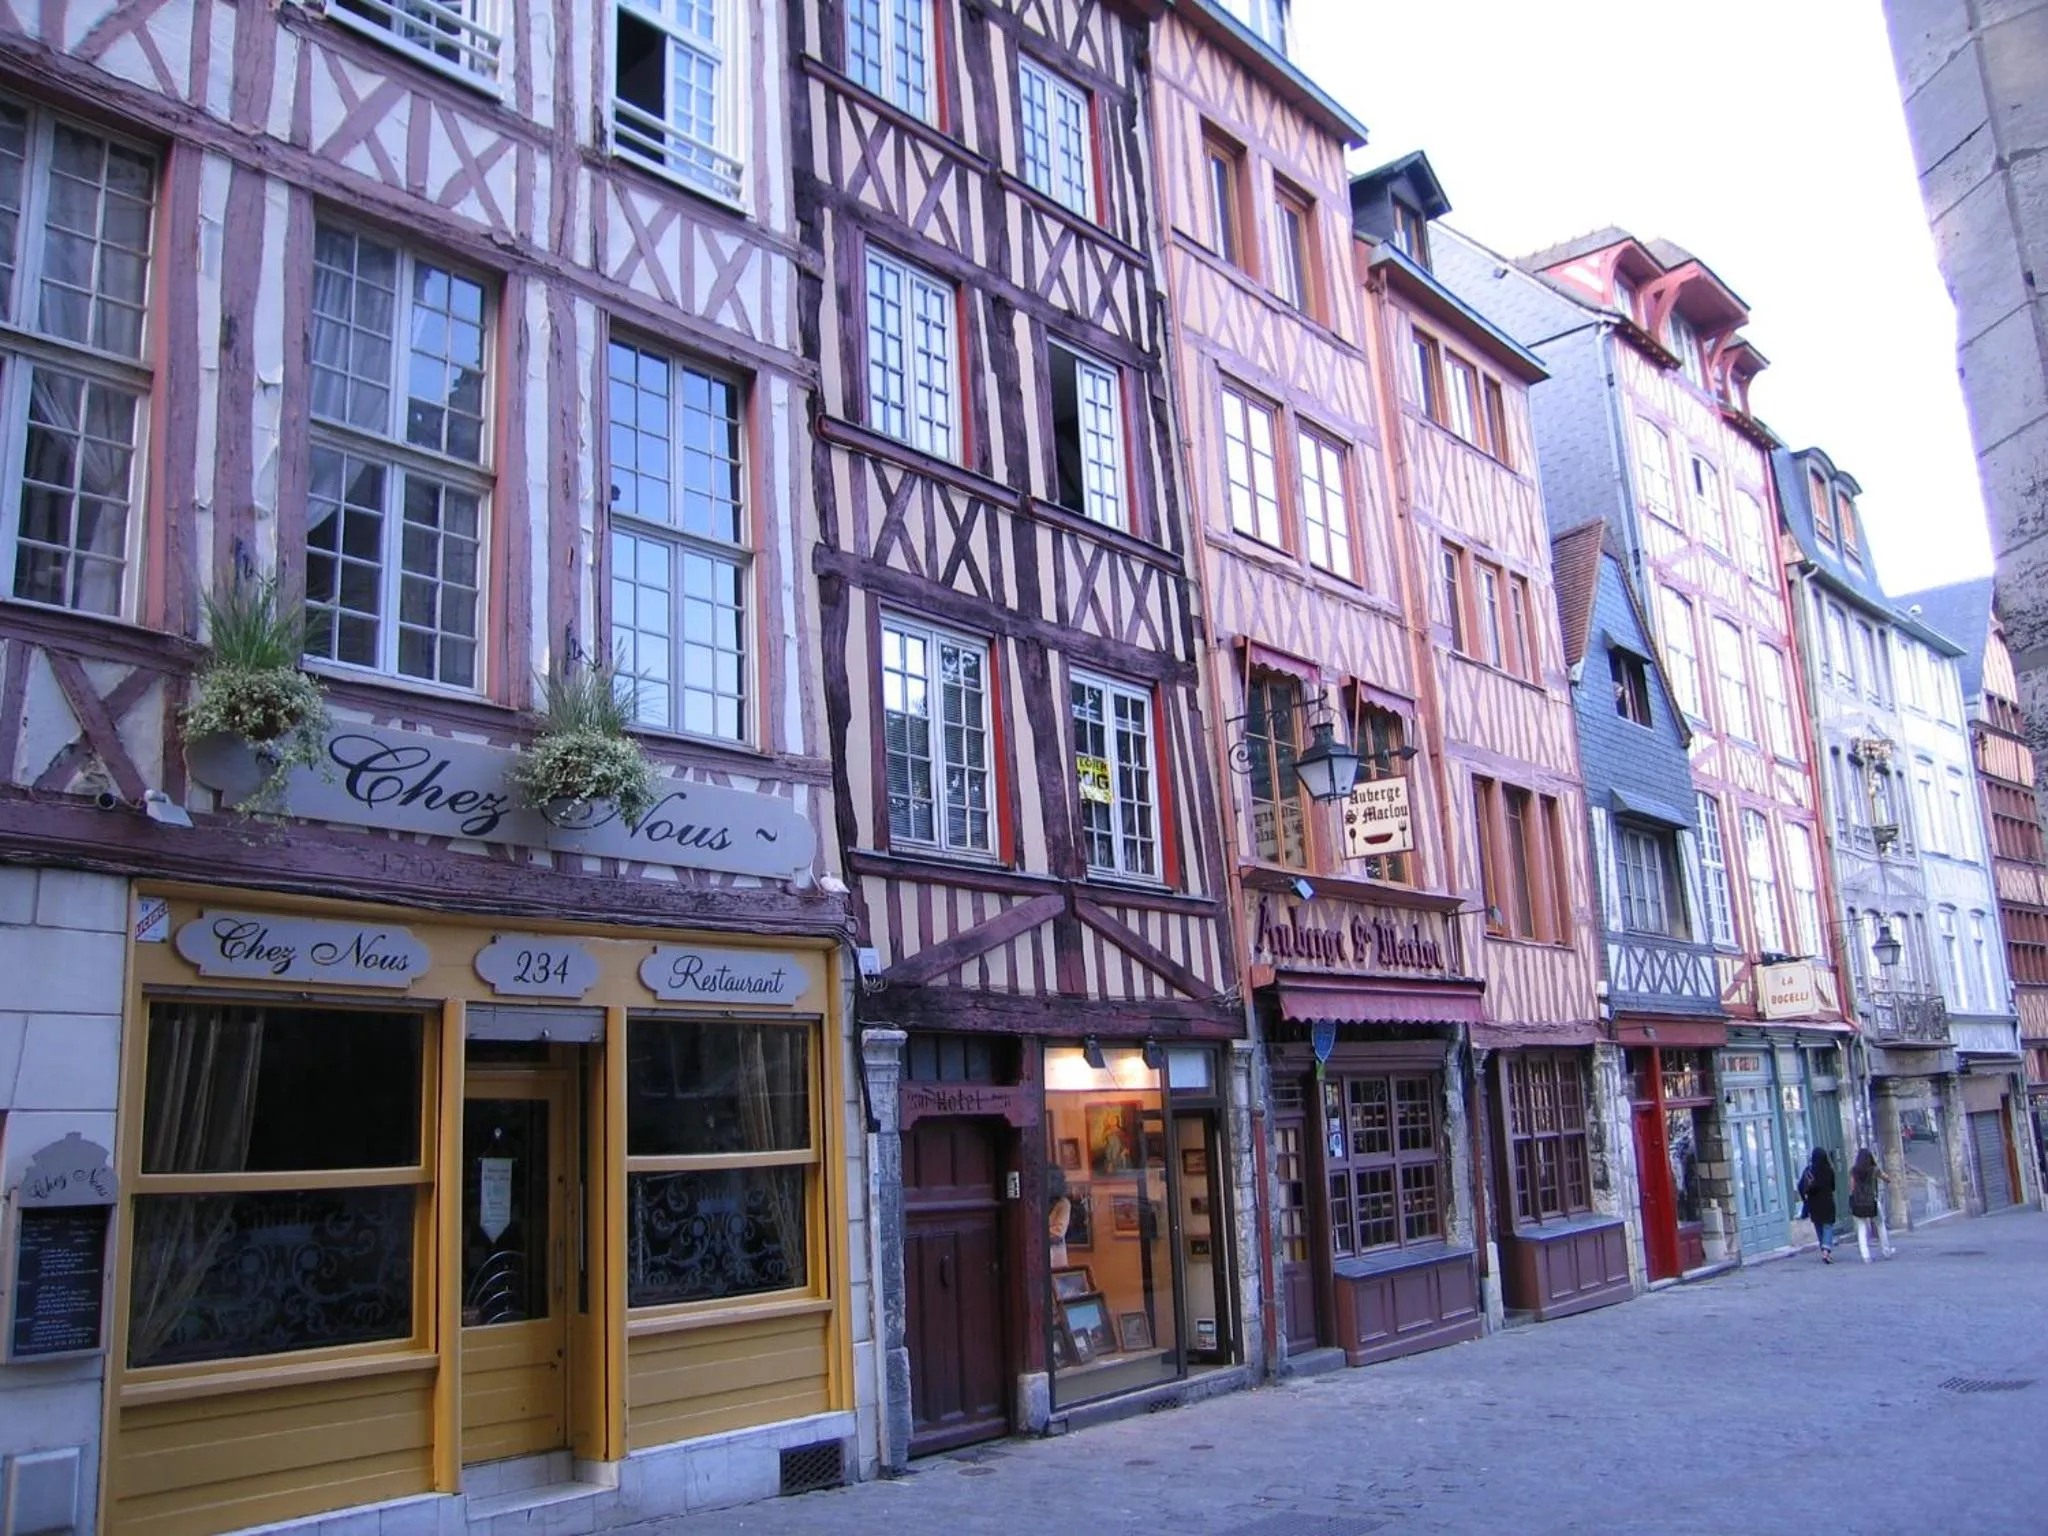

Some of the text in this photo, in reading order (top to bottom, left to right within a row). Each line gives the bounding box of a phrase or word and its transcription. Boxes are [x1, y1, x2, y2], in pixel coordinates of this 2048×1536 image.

[328, 733, 511, 837] Chez
[1349, 785, 1401, 805] Auberge
[212, 918, 409, 974] Chez Nous
[1254, 896, 1347, 967] Auberge
[513, 950, 570, 985] 234
[668, 954, 787, 994] Restaurant
[1781, 976, 1794, 986] LA
